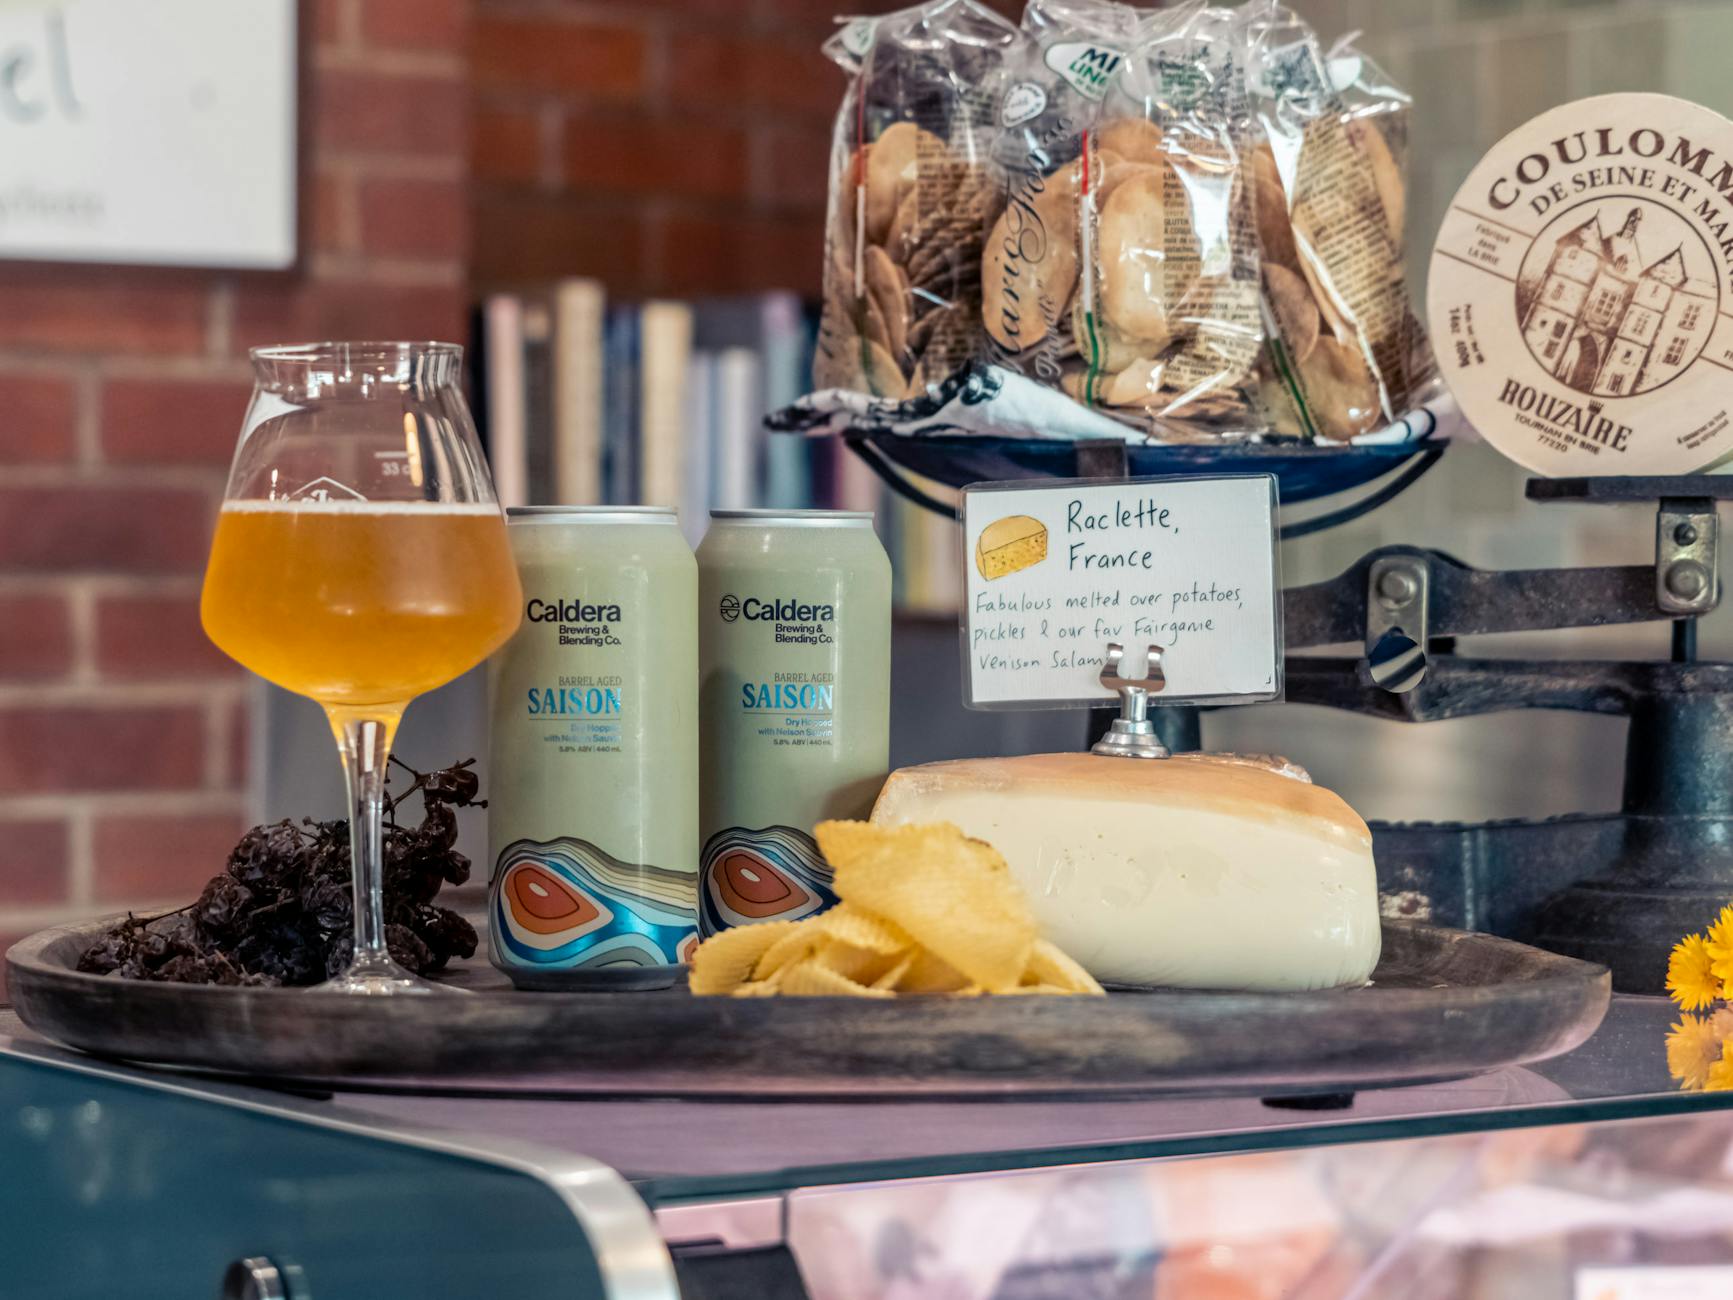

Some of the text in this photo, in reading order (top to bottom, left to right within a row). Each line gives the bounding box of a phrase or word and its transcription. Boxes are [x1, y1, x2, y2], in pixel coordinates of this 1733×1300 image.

[1529, 182, 1568, 216] DE
[1571, 166, 1656, 193] SEINE
[1660, 174, 1698, 203] ET
[1498, 378, 1632, 452] ROUZAIRE
[1515, 413, 1563, 439] TOURNAN
[1067, 498, 1179, 534] Raclette,
[1070, 542, 1153, 571] France
[743, 597, 834, 621] Caldera
[976, 581, 1242, 614] Fabulous melted over potatoes,
[527, 598, 622, 623] Caldera
[559, 624, 610, 637] Brewing &
[775, 623, 824, 635] Brewing &
[775, 633, 834, 645] Blending Co.
[974, 621, 1026, 650] pickles
[1059, 626, 1086, 639] our
[1094, 617, 1123, 639] fav
[559, 635, 622, 648] Blending Co.
[558, 675, 622, 687] BARREL AGED
[774, 672, 834, 683] BARREL AGED
[527, 687, 622, 715] SAISON
[742, 682, 834, 710] SAISON
[758, 727, 775, 737] with
[776, 727, 805, 737] Nelson
[785, 718, 800, 728] Dry
[791, 738, 806, 746] ABV
